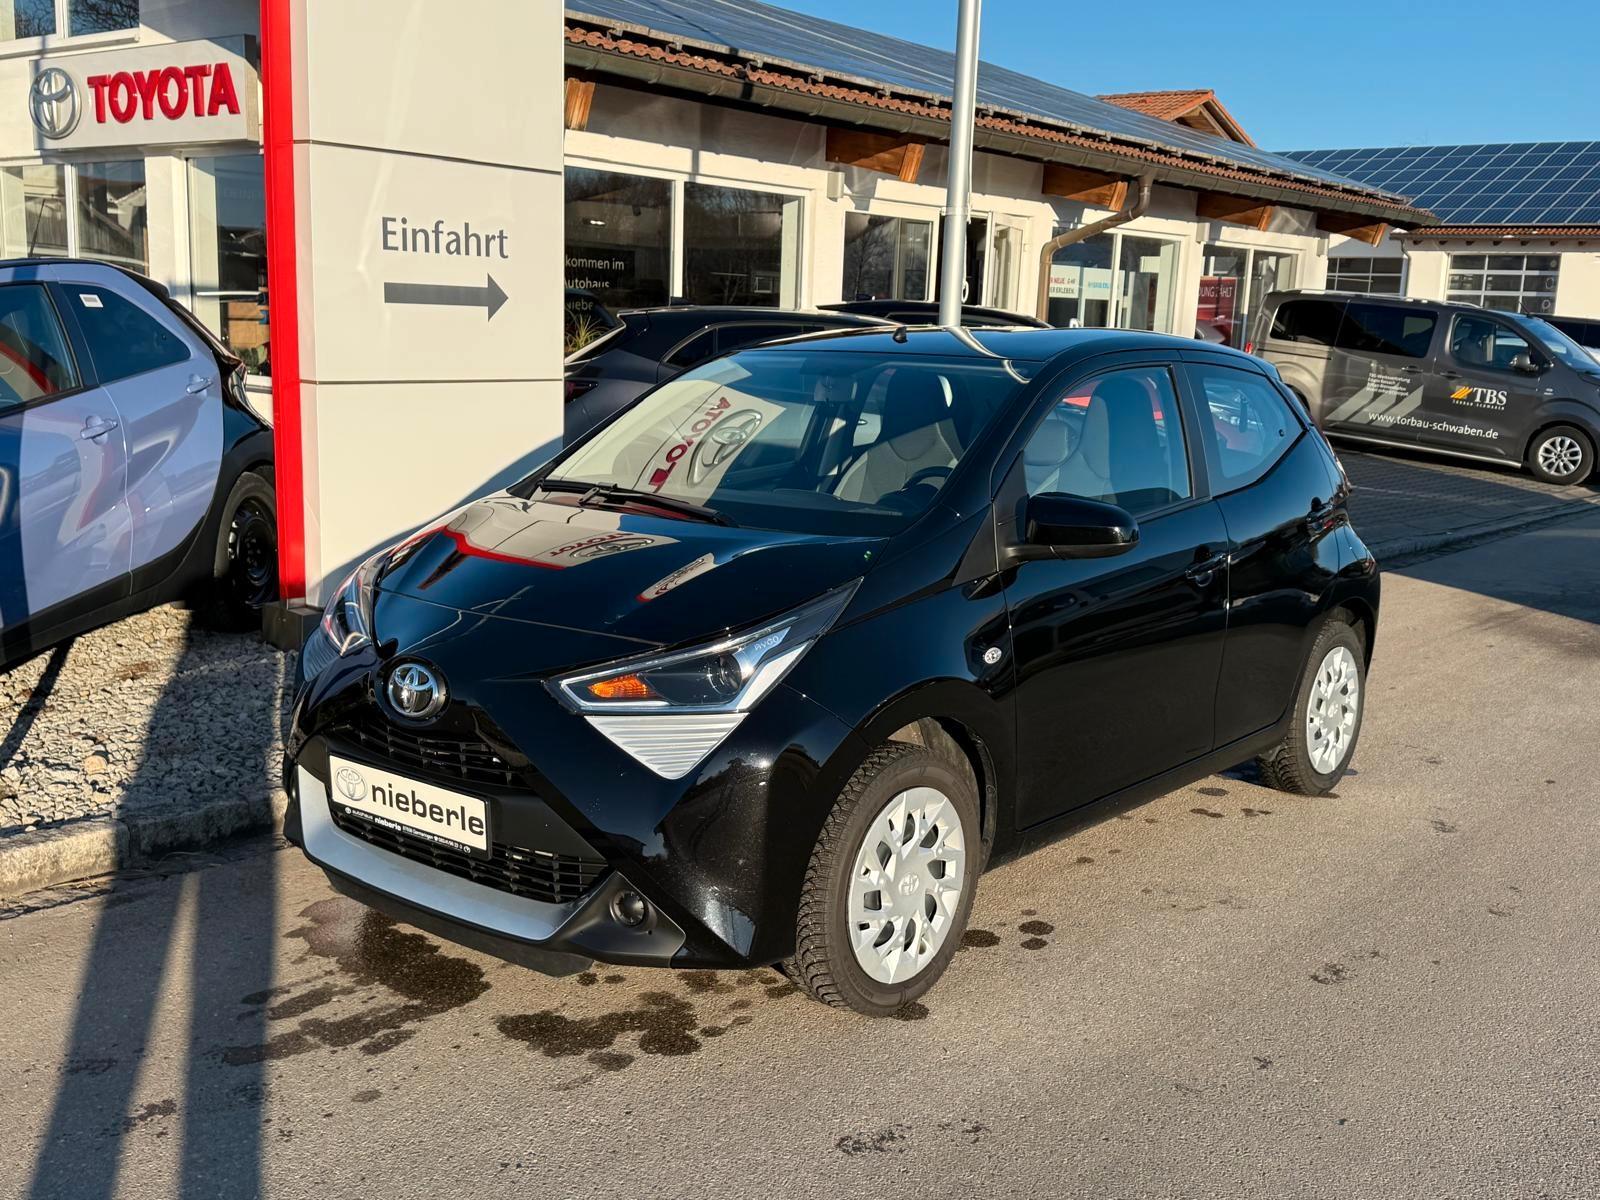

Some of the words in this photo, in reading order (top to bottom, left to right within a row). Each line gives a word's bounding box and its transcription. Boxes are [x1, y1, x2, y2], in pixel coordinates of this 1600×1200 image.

[87, 62, 240, 124] TOYOTA
[382, 217, 509, 260] Einfahrt
[612, 257, 625, 271] im
[1473, 387, 1508, 406] TBS
[1368, 411, 1499, 440] www.torbau-schwaben.de
[371, 782, 485, 836] nieberle
[374, 816, 402, 832] nieberle
